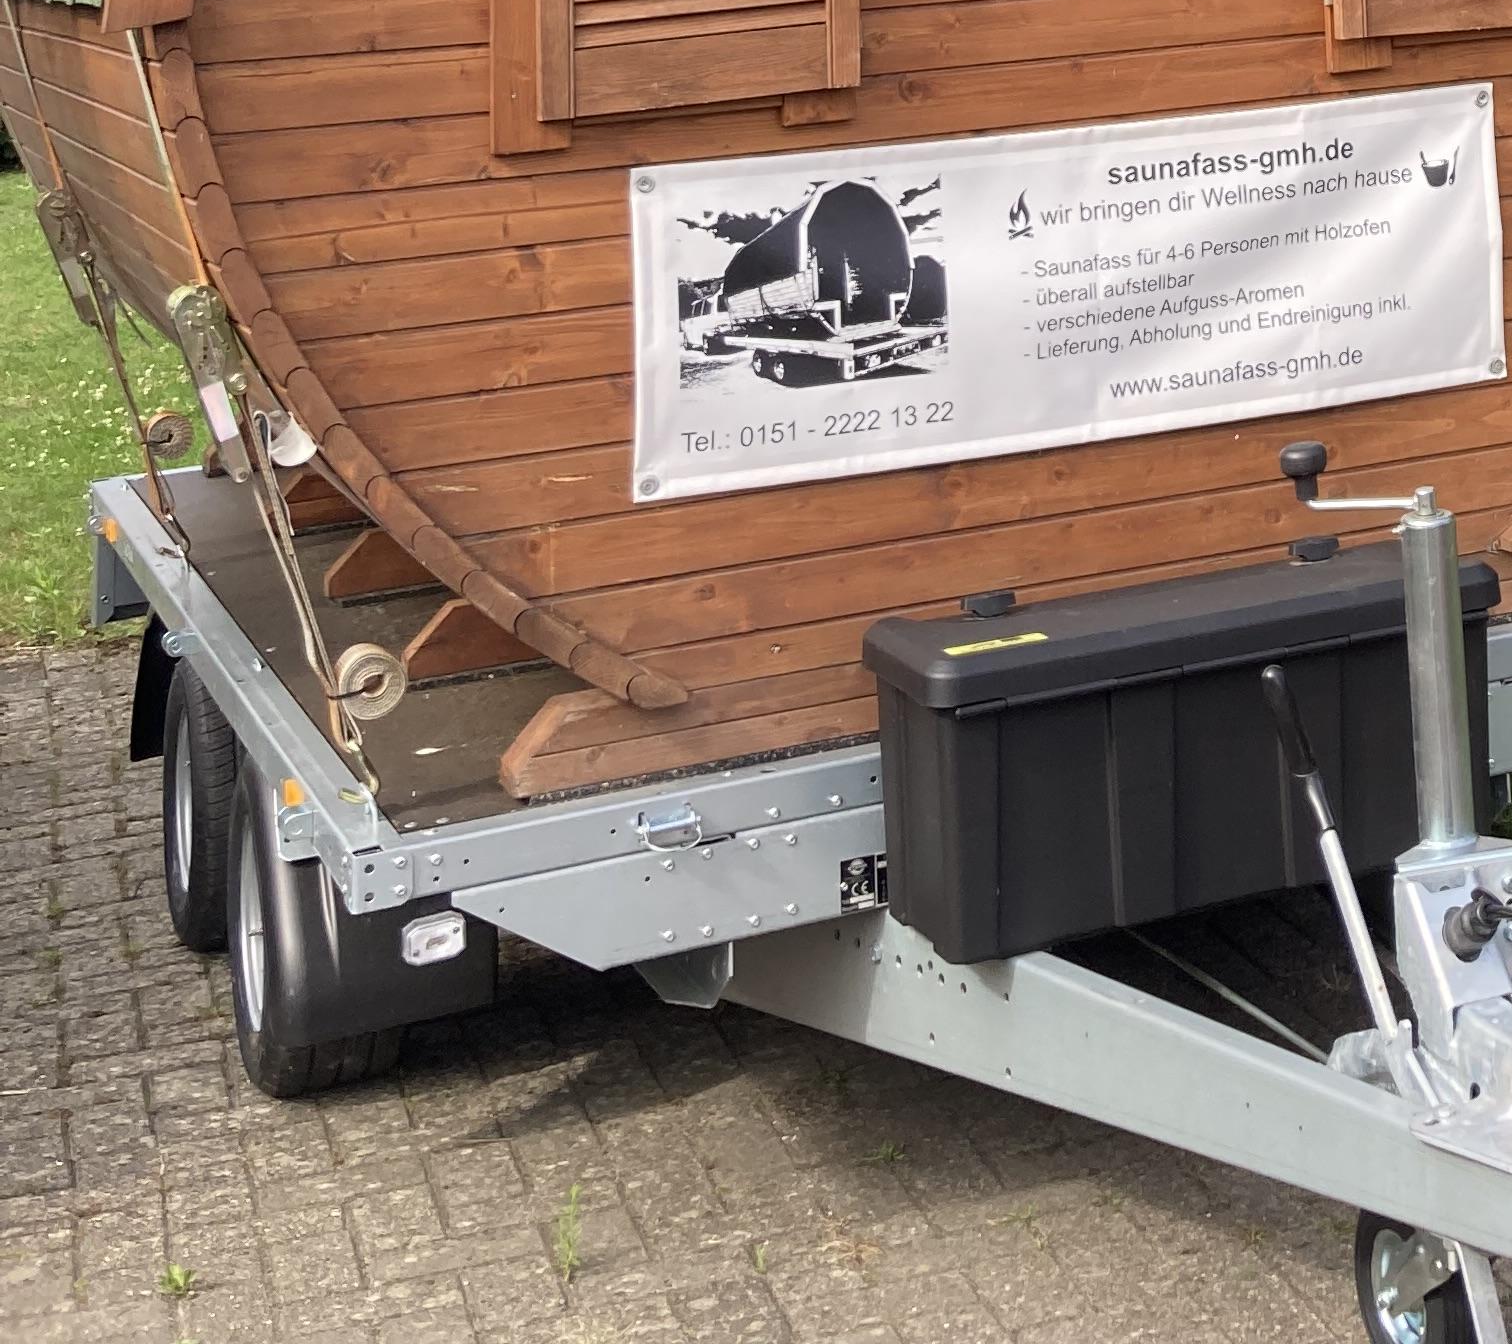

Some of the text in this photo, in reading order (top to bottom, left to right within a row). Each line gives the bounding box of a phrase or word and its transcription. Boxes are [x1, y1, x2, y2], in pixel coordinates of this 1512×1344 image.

[1108, 138, 1354, 185] saunafass-gmh.de
[1040, 167, 1413, 226] wir bringen dir Wellness nach hause
[1034, 254, 1132, 278] Saunafass
[1137, 248, 1162, 265] für
[1166, 243, 1196, 261] 4-6
[1201, 234, 1280, 258] Personen
[1285, 228, 1310, 246] mit
[1315, 219, 1392, 242] Holzofen
[1036, 282, 1098, 306] überall
[1104, 272, 1196, 298] aufstellbar
[1037, 304, 1156, 332] verschiedene
[1160, 284, 1305, 316] Aufguss-Aromen
[1037, 335, 1124, 360] Lieferung,
[1129, 322, 1213, 346] Abholung
[1218, 317, 1252, 335] und
[1258, 301, 1374, 330] Endreinigung
[1378, 293, 1411, 312] inkl.
[1110, 346, 1364, 399] www.saunafass-gmh.de
[681, 430, 731, 453] Tel.:
[740, 420, 798, 447] 0151
[824, 409, 881, 437] 2222
[891, 405, 917, 428] 13
[926, 401, 954, 423] 22
